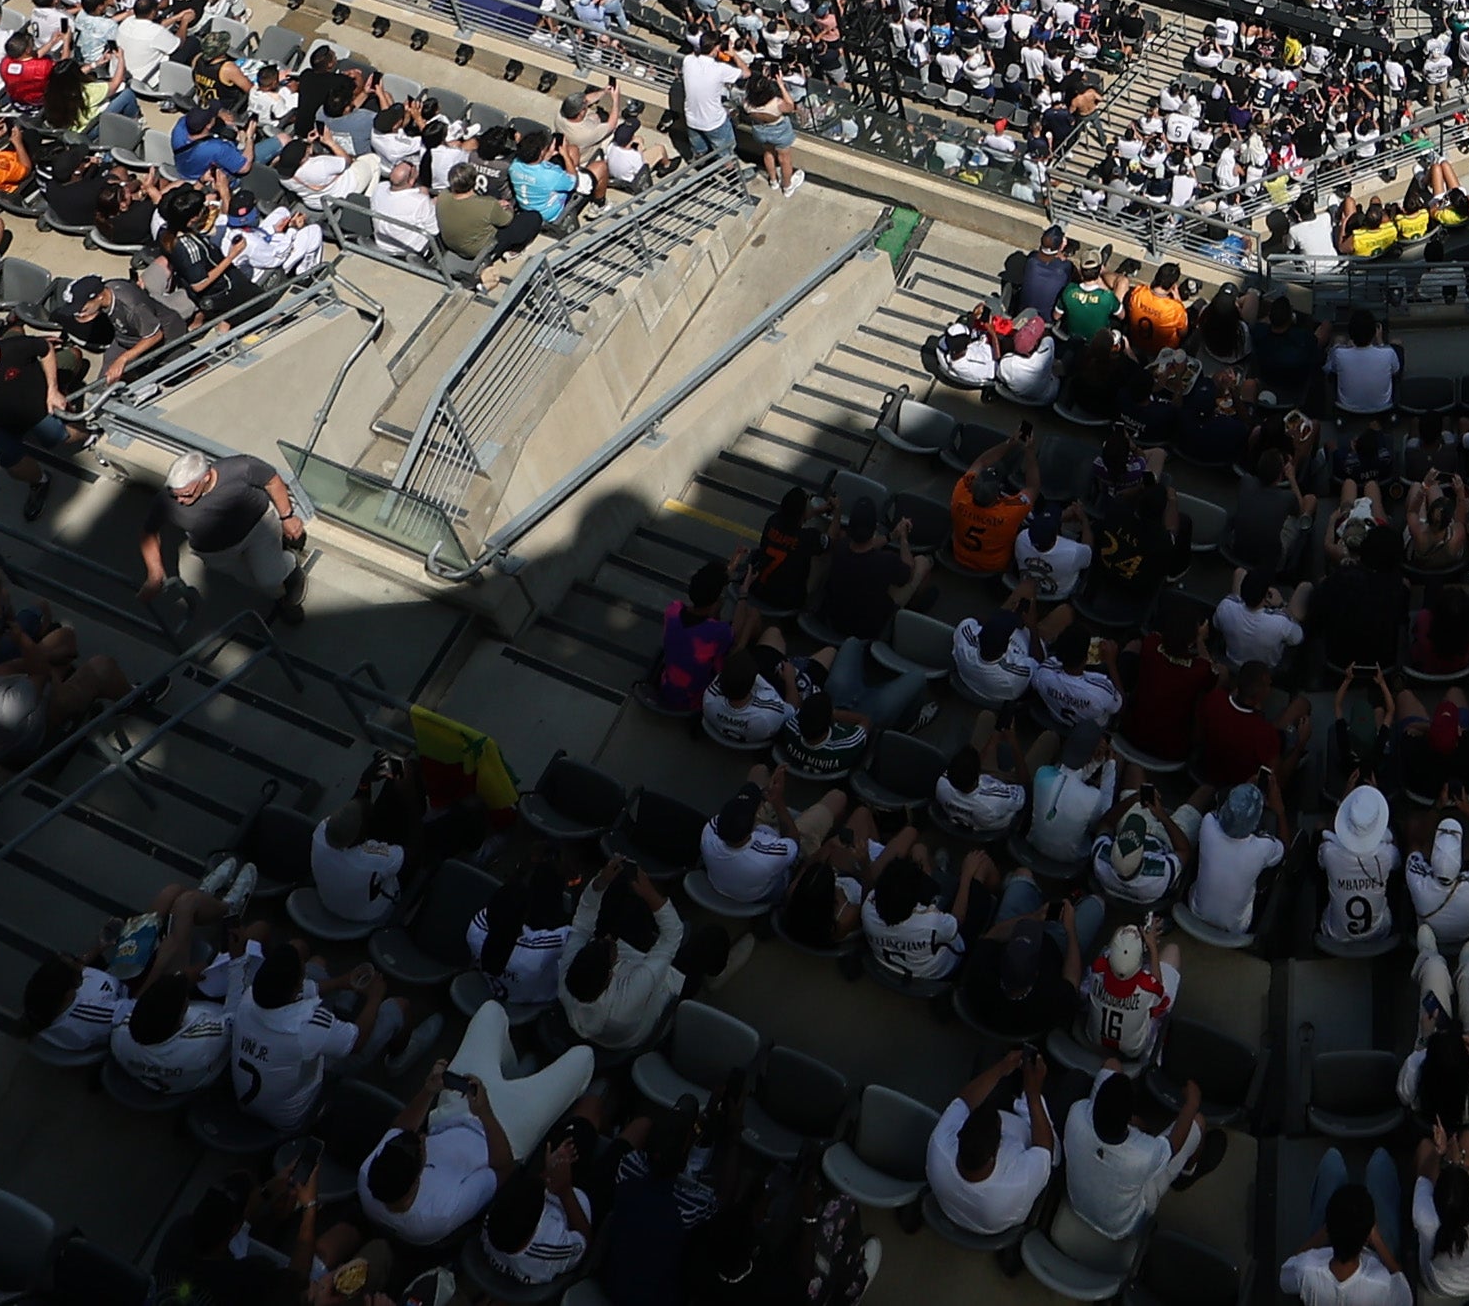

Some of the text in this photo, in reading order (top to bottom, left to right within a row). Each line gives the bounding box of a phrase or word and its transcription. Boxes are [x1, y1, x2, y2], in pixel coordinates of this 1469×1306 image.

[964, 527, 986, 552] 5
[1346, 896, 1372, 935] 9
[883, 948, 914, 978] 5
[1101, 1007, 1124, 1041] 16
[238, 1058, 262, 1106] 7
